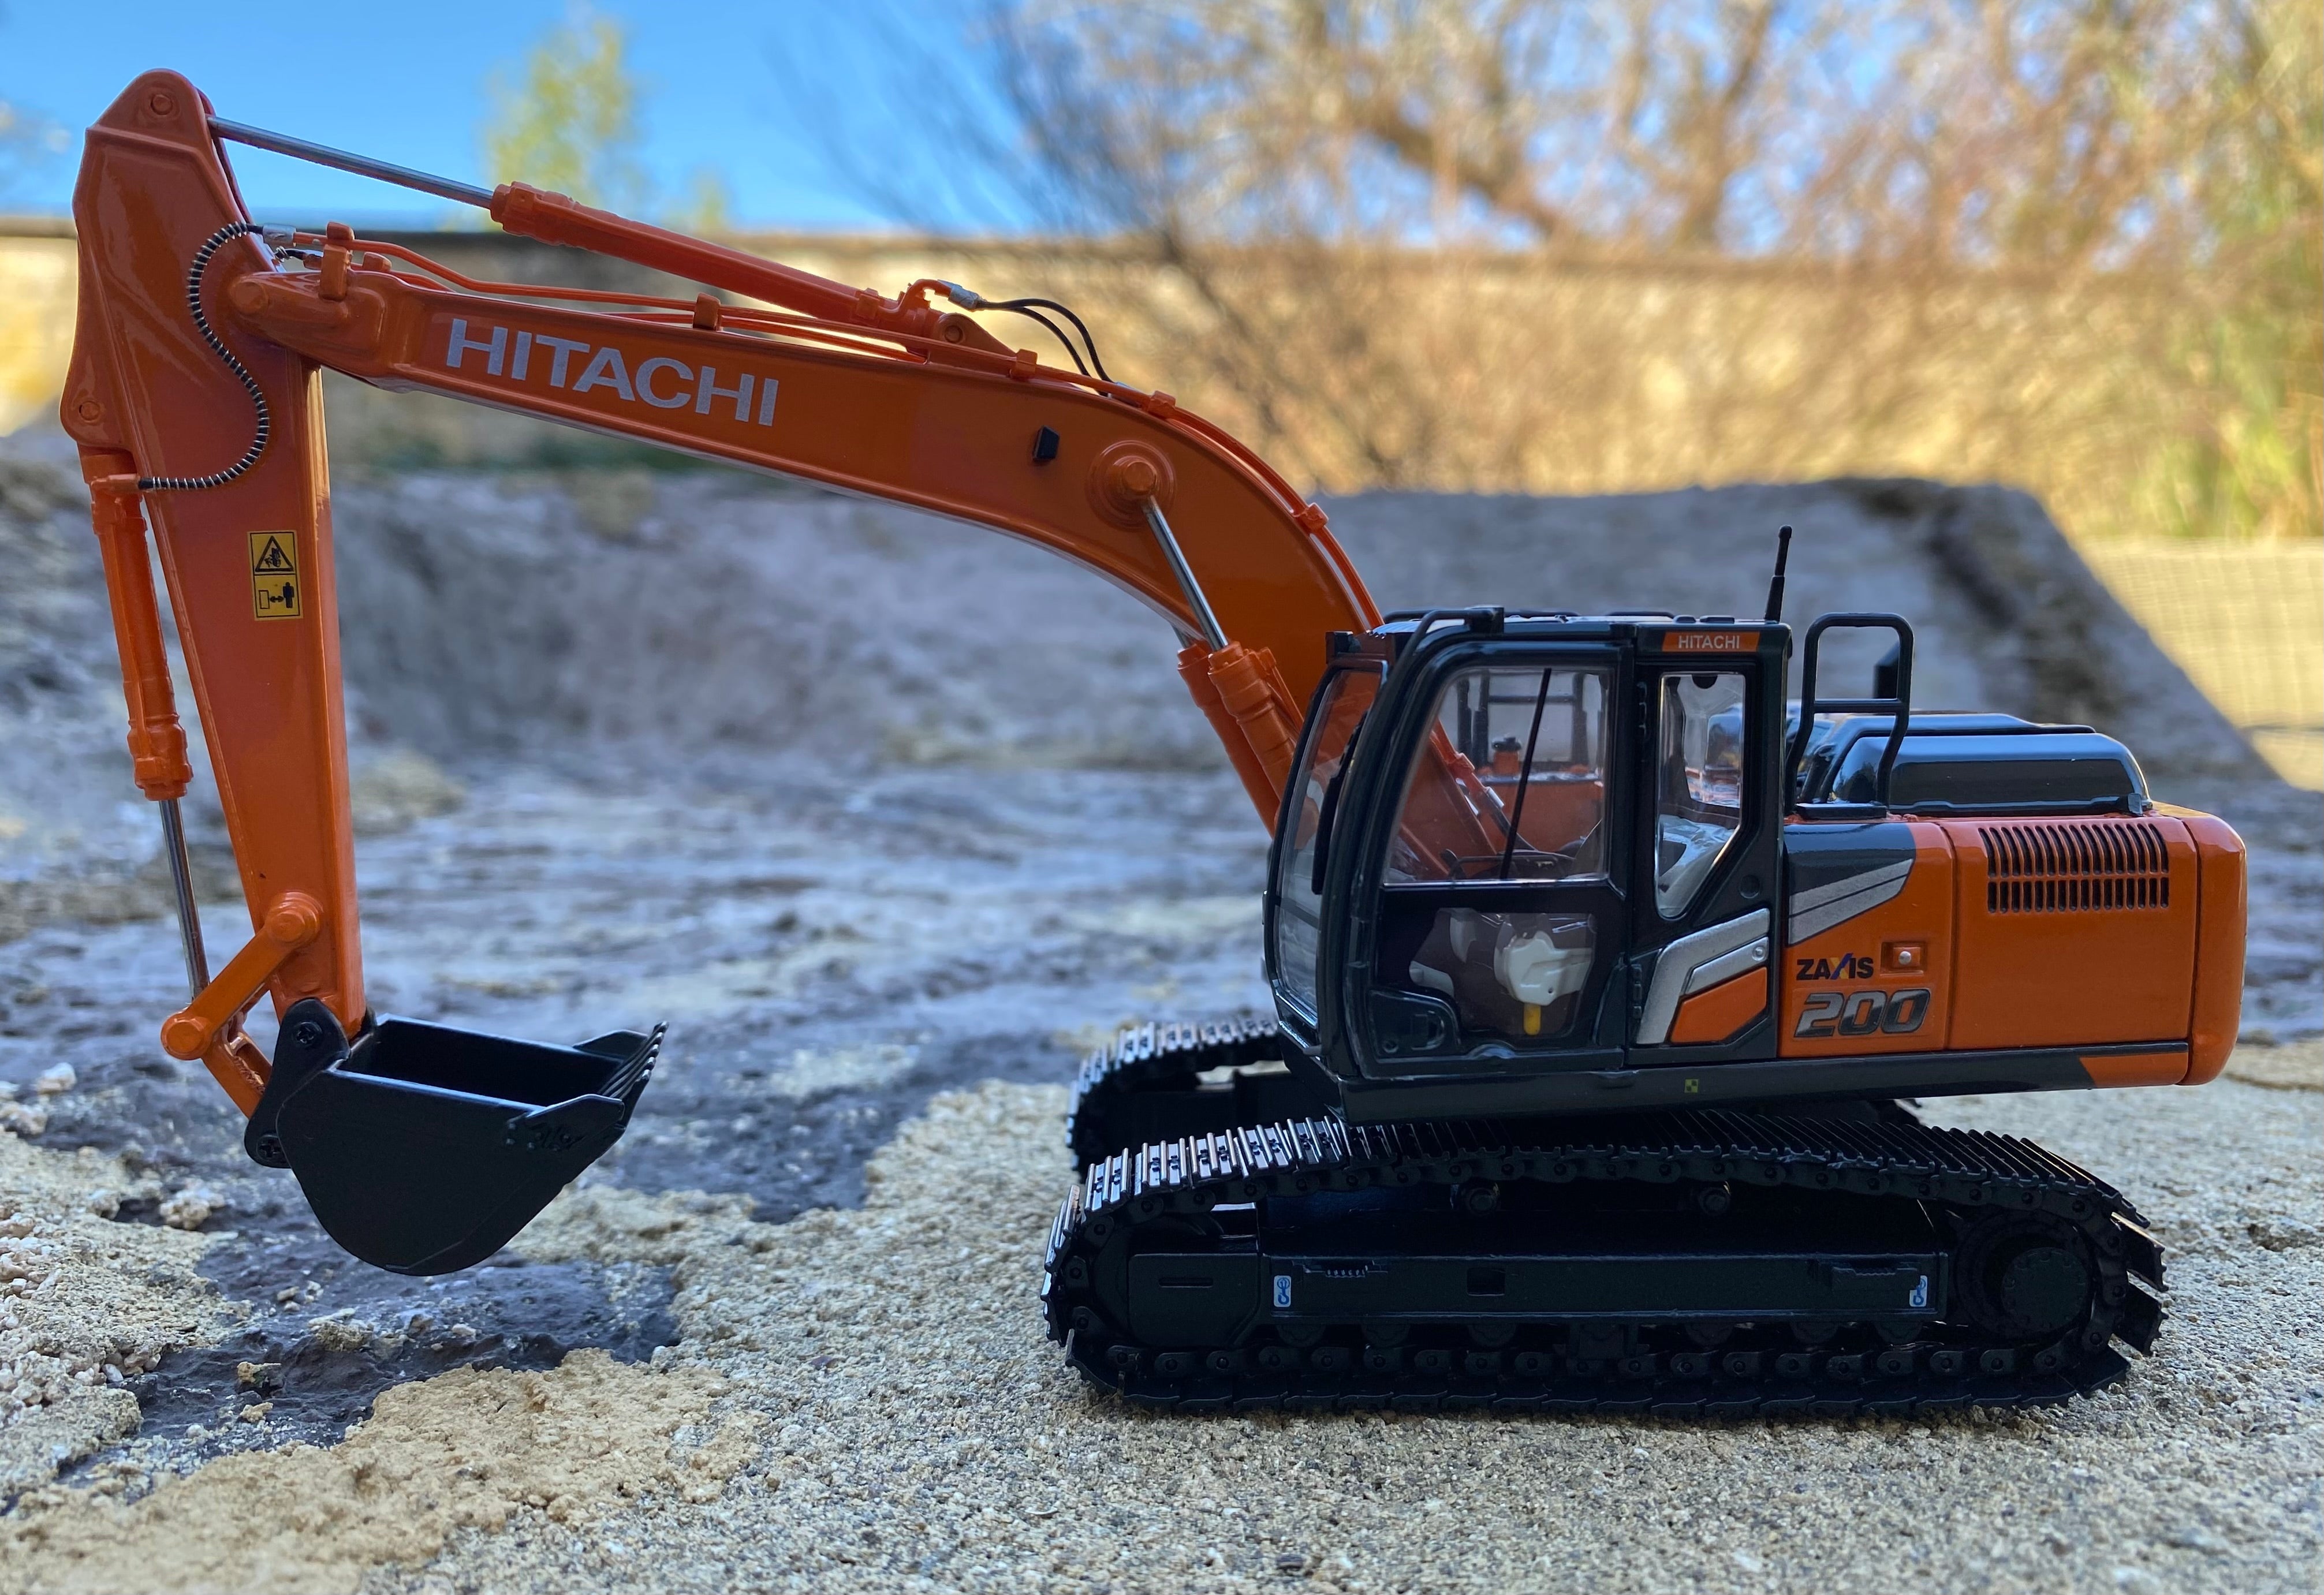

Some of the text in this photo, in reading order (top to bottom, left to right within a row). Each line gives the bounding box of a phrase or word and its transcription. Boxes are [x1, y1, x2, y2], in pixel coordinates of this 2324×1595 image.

[446, 318, 778, 426] HITACHI
[1678, 635, 1740, 649] HITACHI
[1796, 952, 1874, 980] ZAXIS
[1793, 988, 1931, 1038] 200
